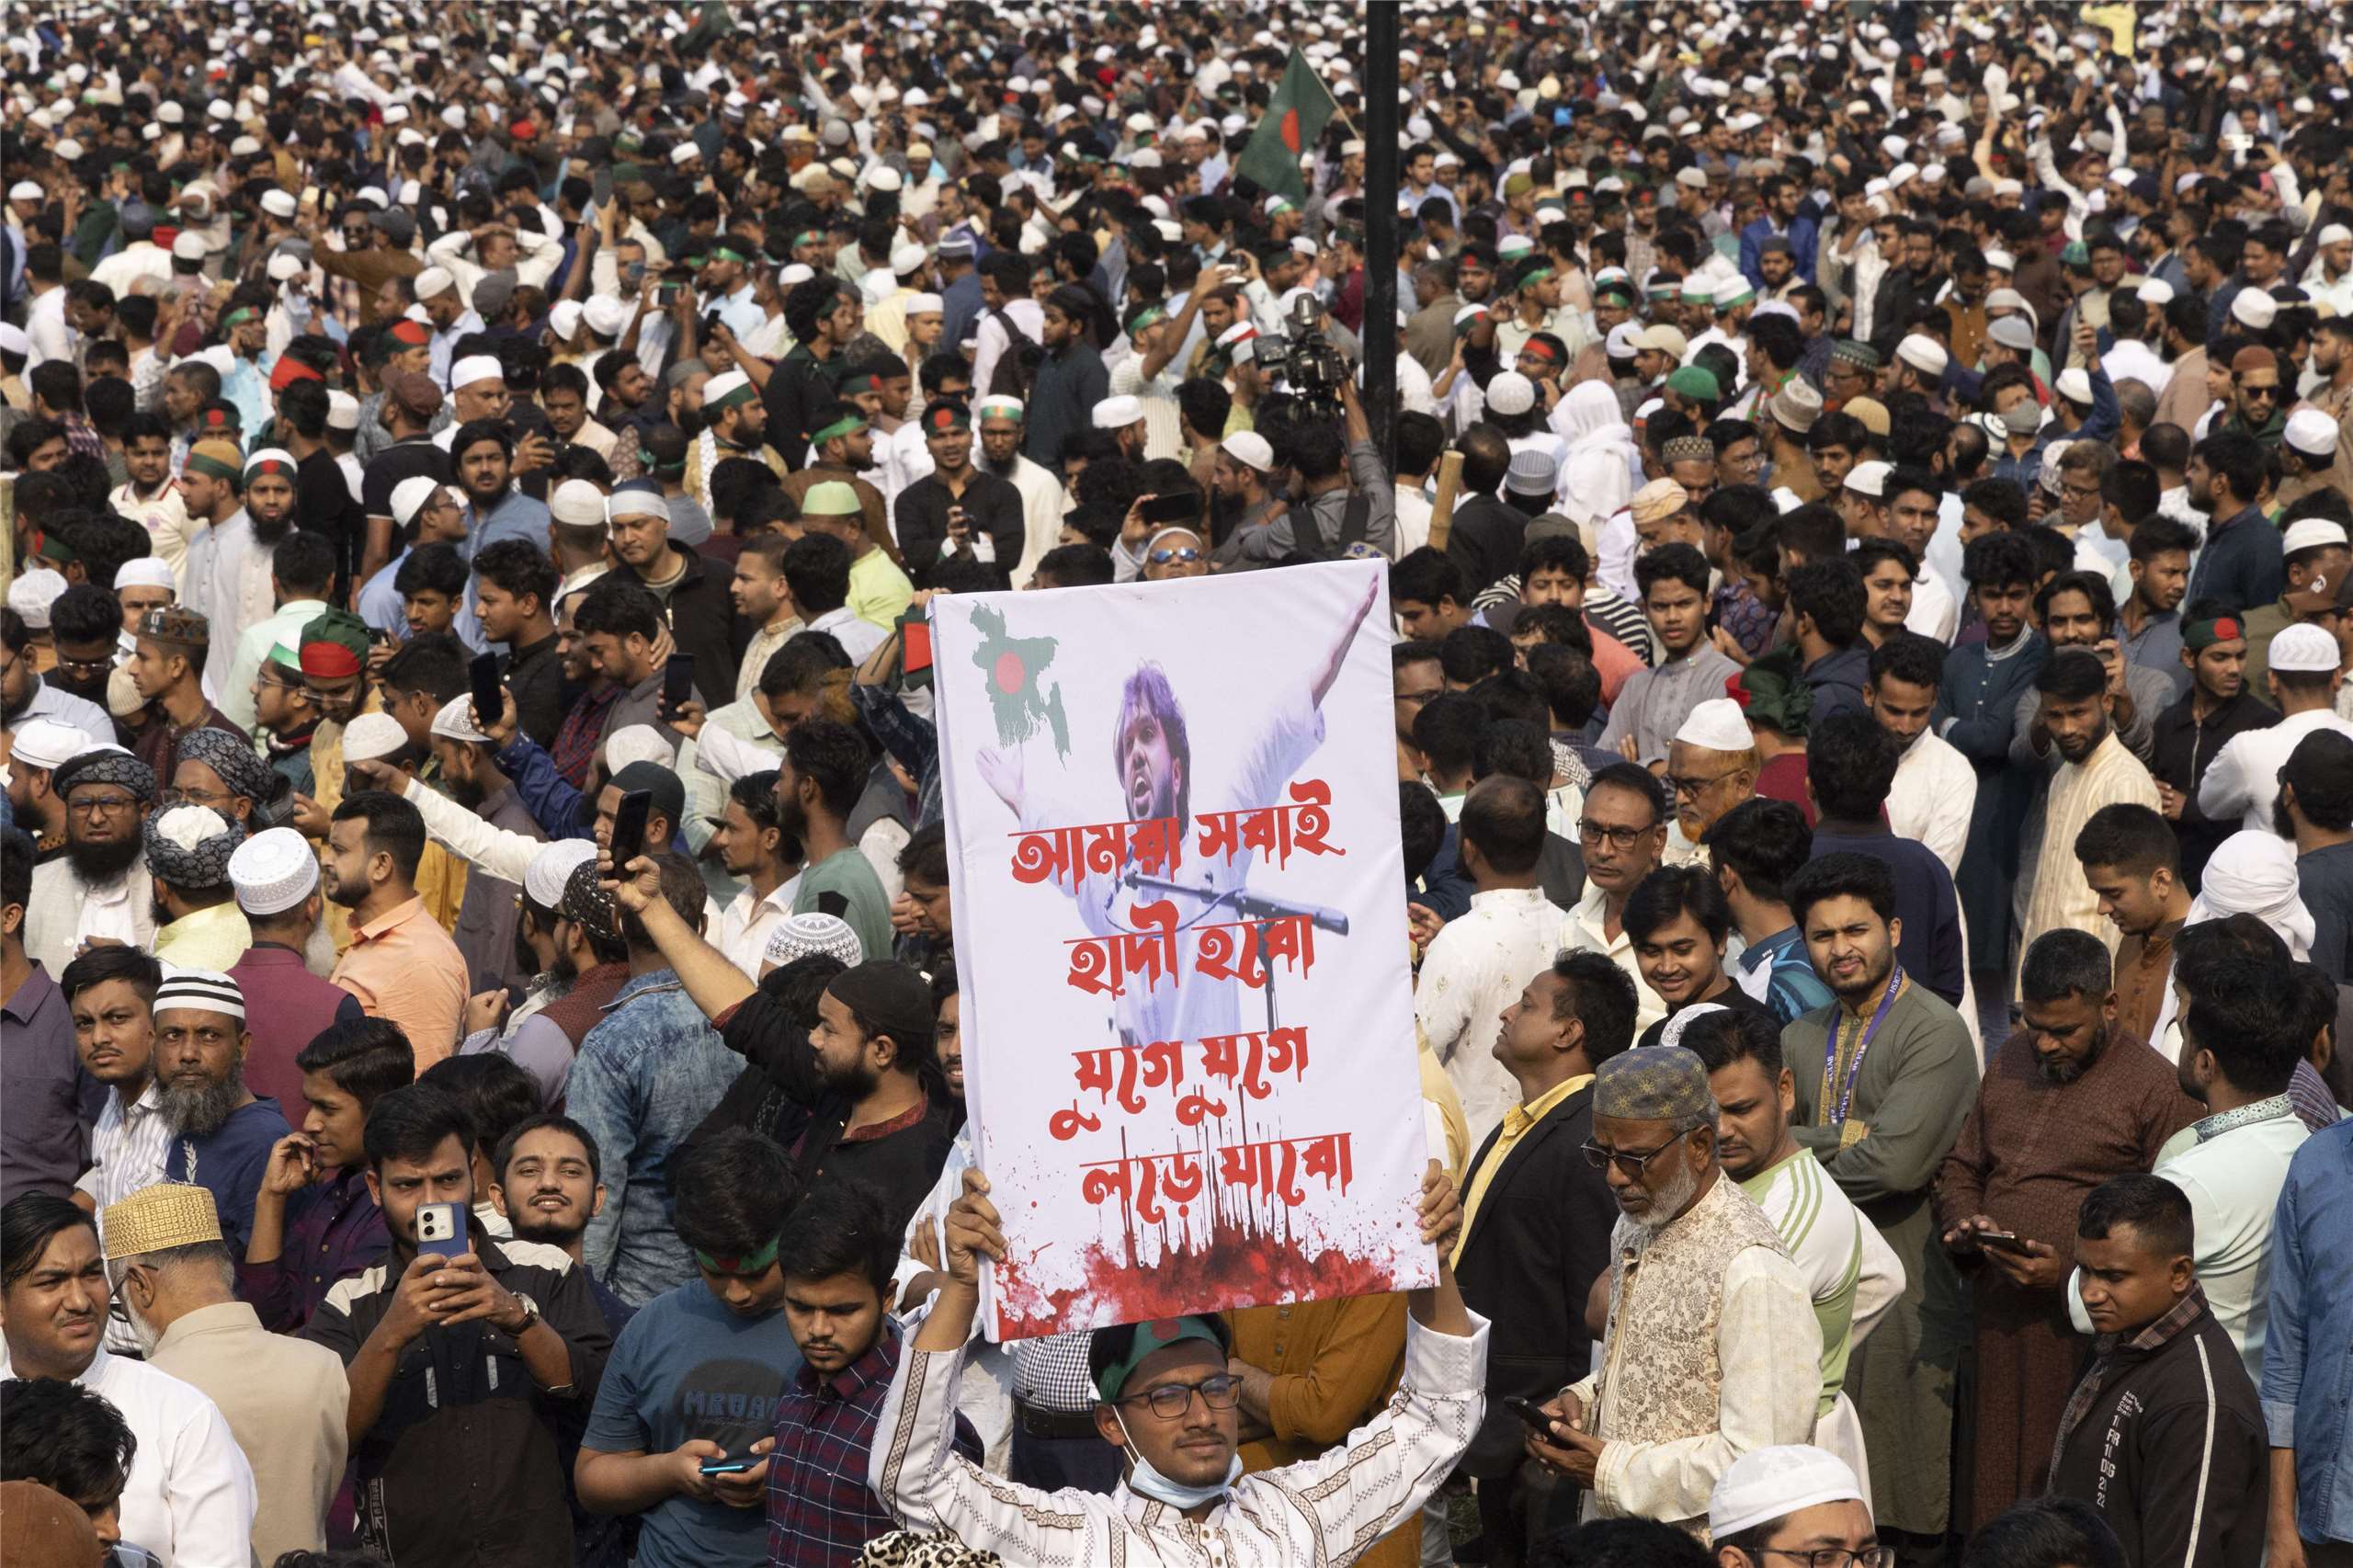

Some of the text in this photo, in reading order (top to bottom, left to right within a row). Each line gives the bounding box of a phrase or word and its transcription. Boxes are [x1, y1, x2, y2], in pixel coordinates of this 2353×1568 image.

[1007, 778, 1346, 895] আমরা সবাই
[1063, 900, 1314, 1001] হাদী হবো
[1050, 1027, 1308, 1141] যুগে যুগে
[1079, 1132, 1353, 1224] লড়ে যাবো
